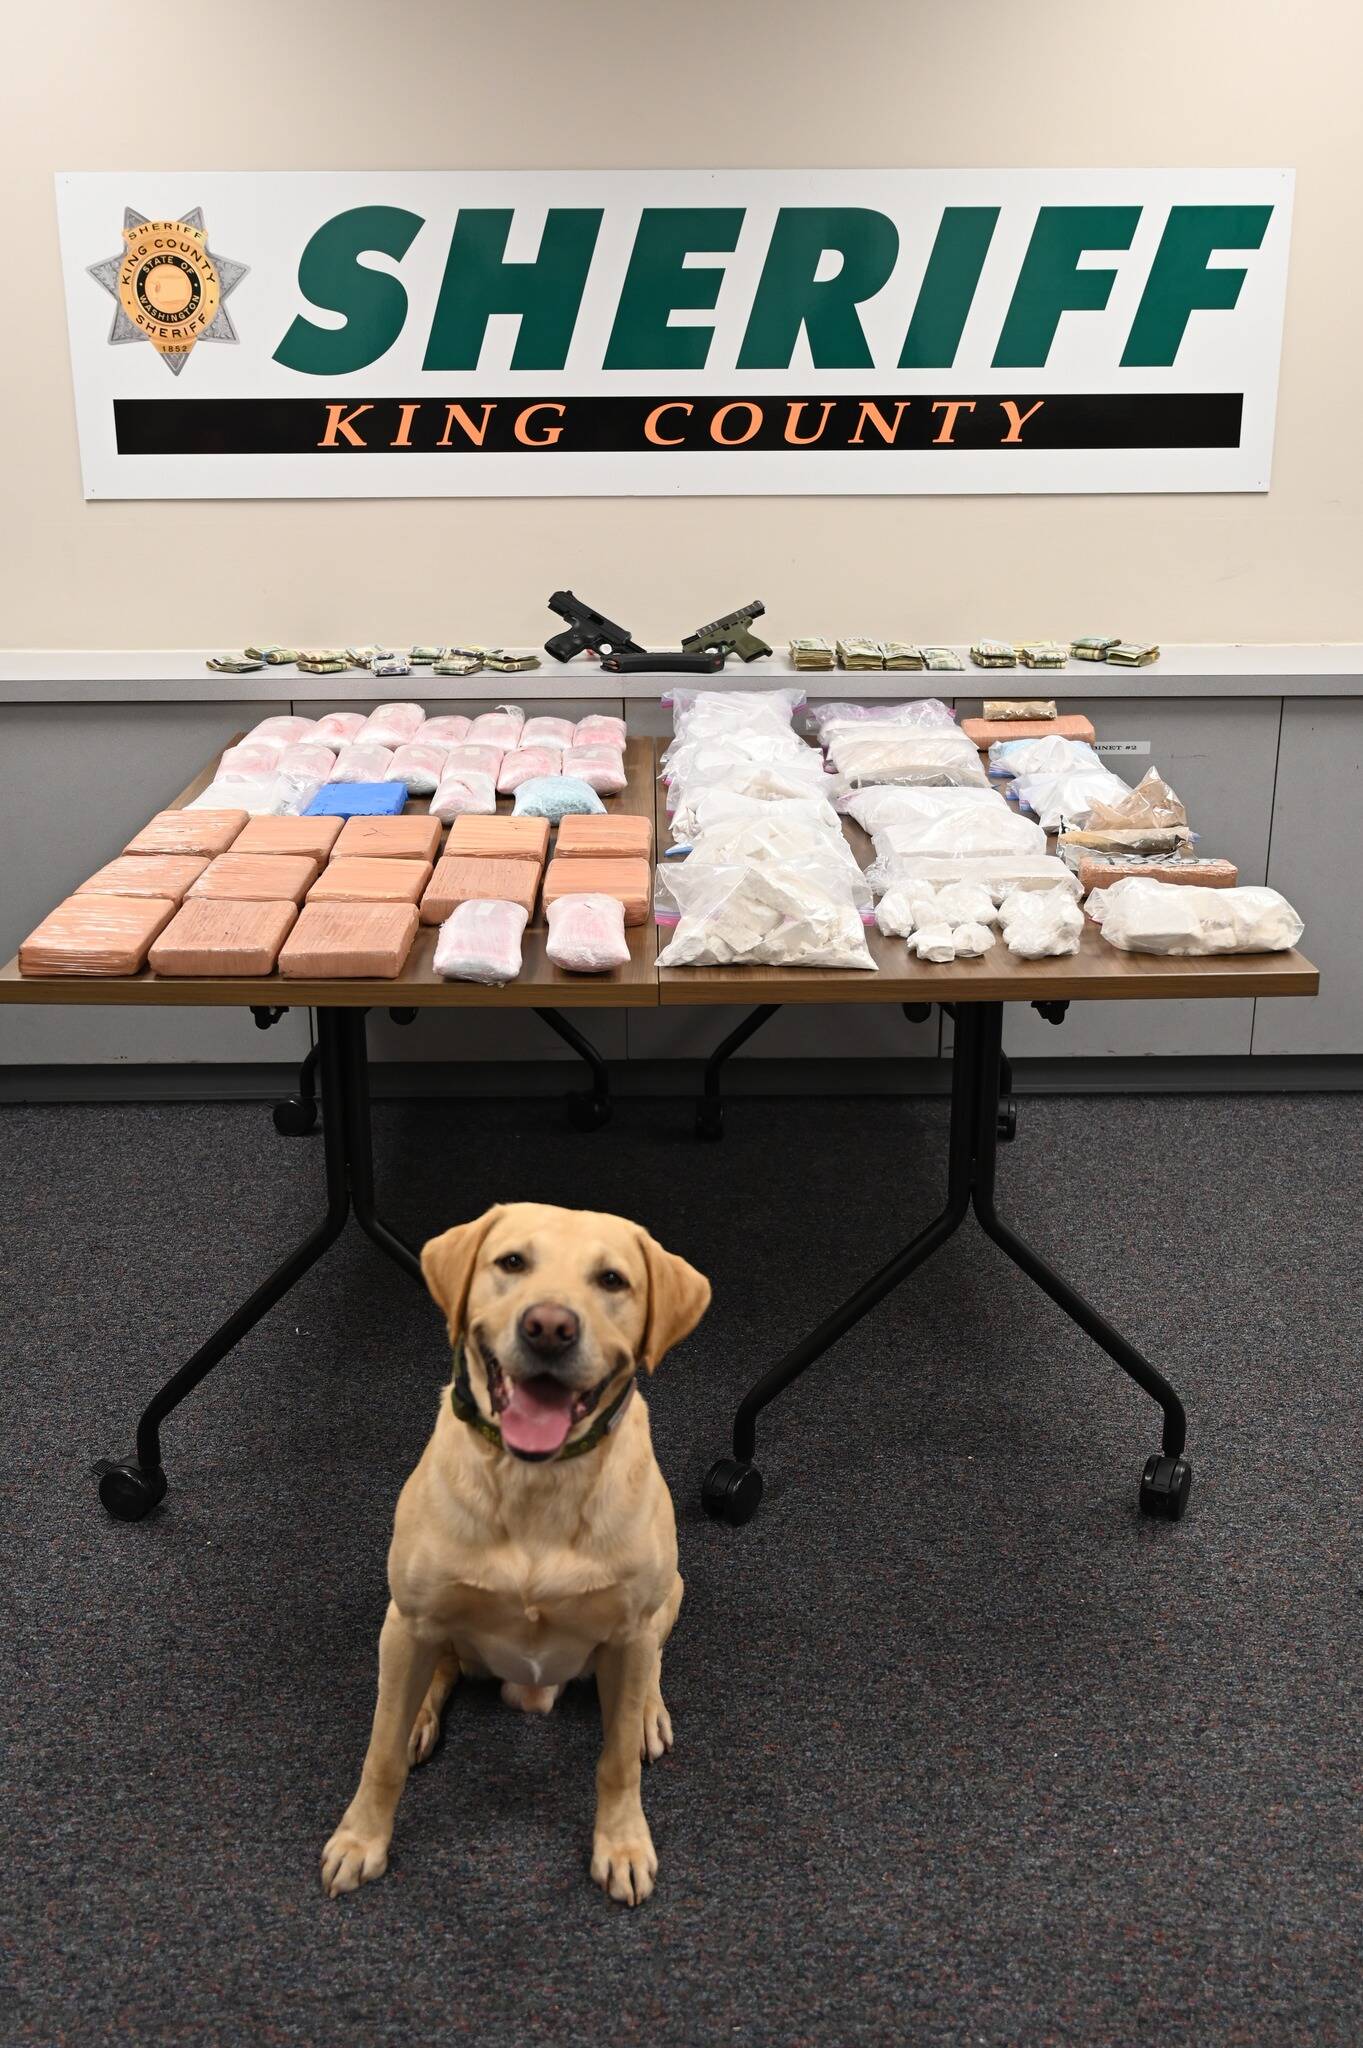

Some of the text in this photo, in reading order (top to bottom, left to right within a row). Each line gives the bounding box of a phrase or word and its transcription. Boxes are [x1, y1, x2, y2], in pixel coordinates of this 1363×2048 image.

[128, 222, 202, 241] SHERIFF
[122, 238, 216, 285] KING COUNTY
[142, 256, 195, 275] STATE OF
[273, 204, 1273, 376] SHERIFF
[139, 294, 200, 322] WASHINGTON
[136, 312, 207, 338] SHERIFF
[162, 345, 188, 353] 1852
[317, 400, 1045, 447] KING COUNTY
